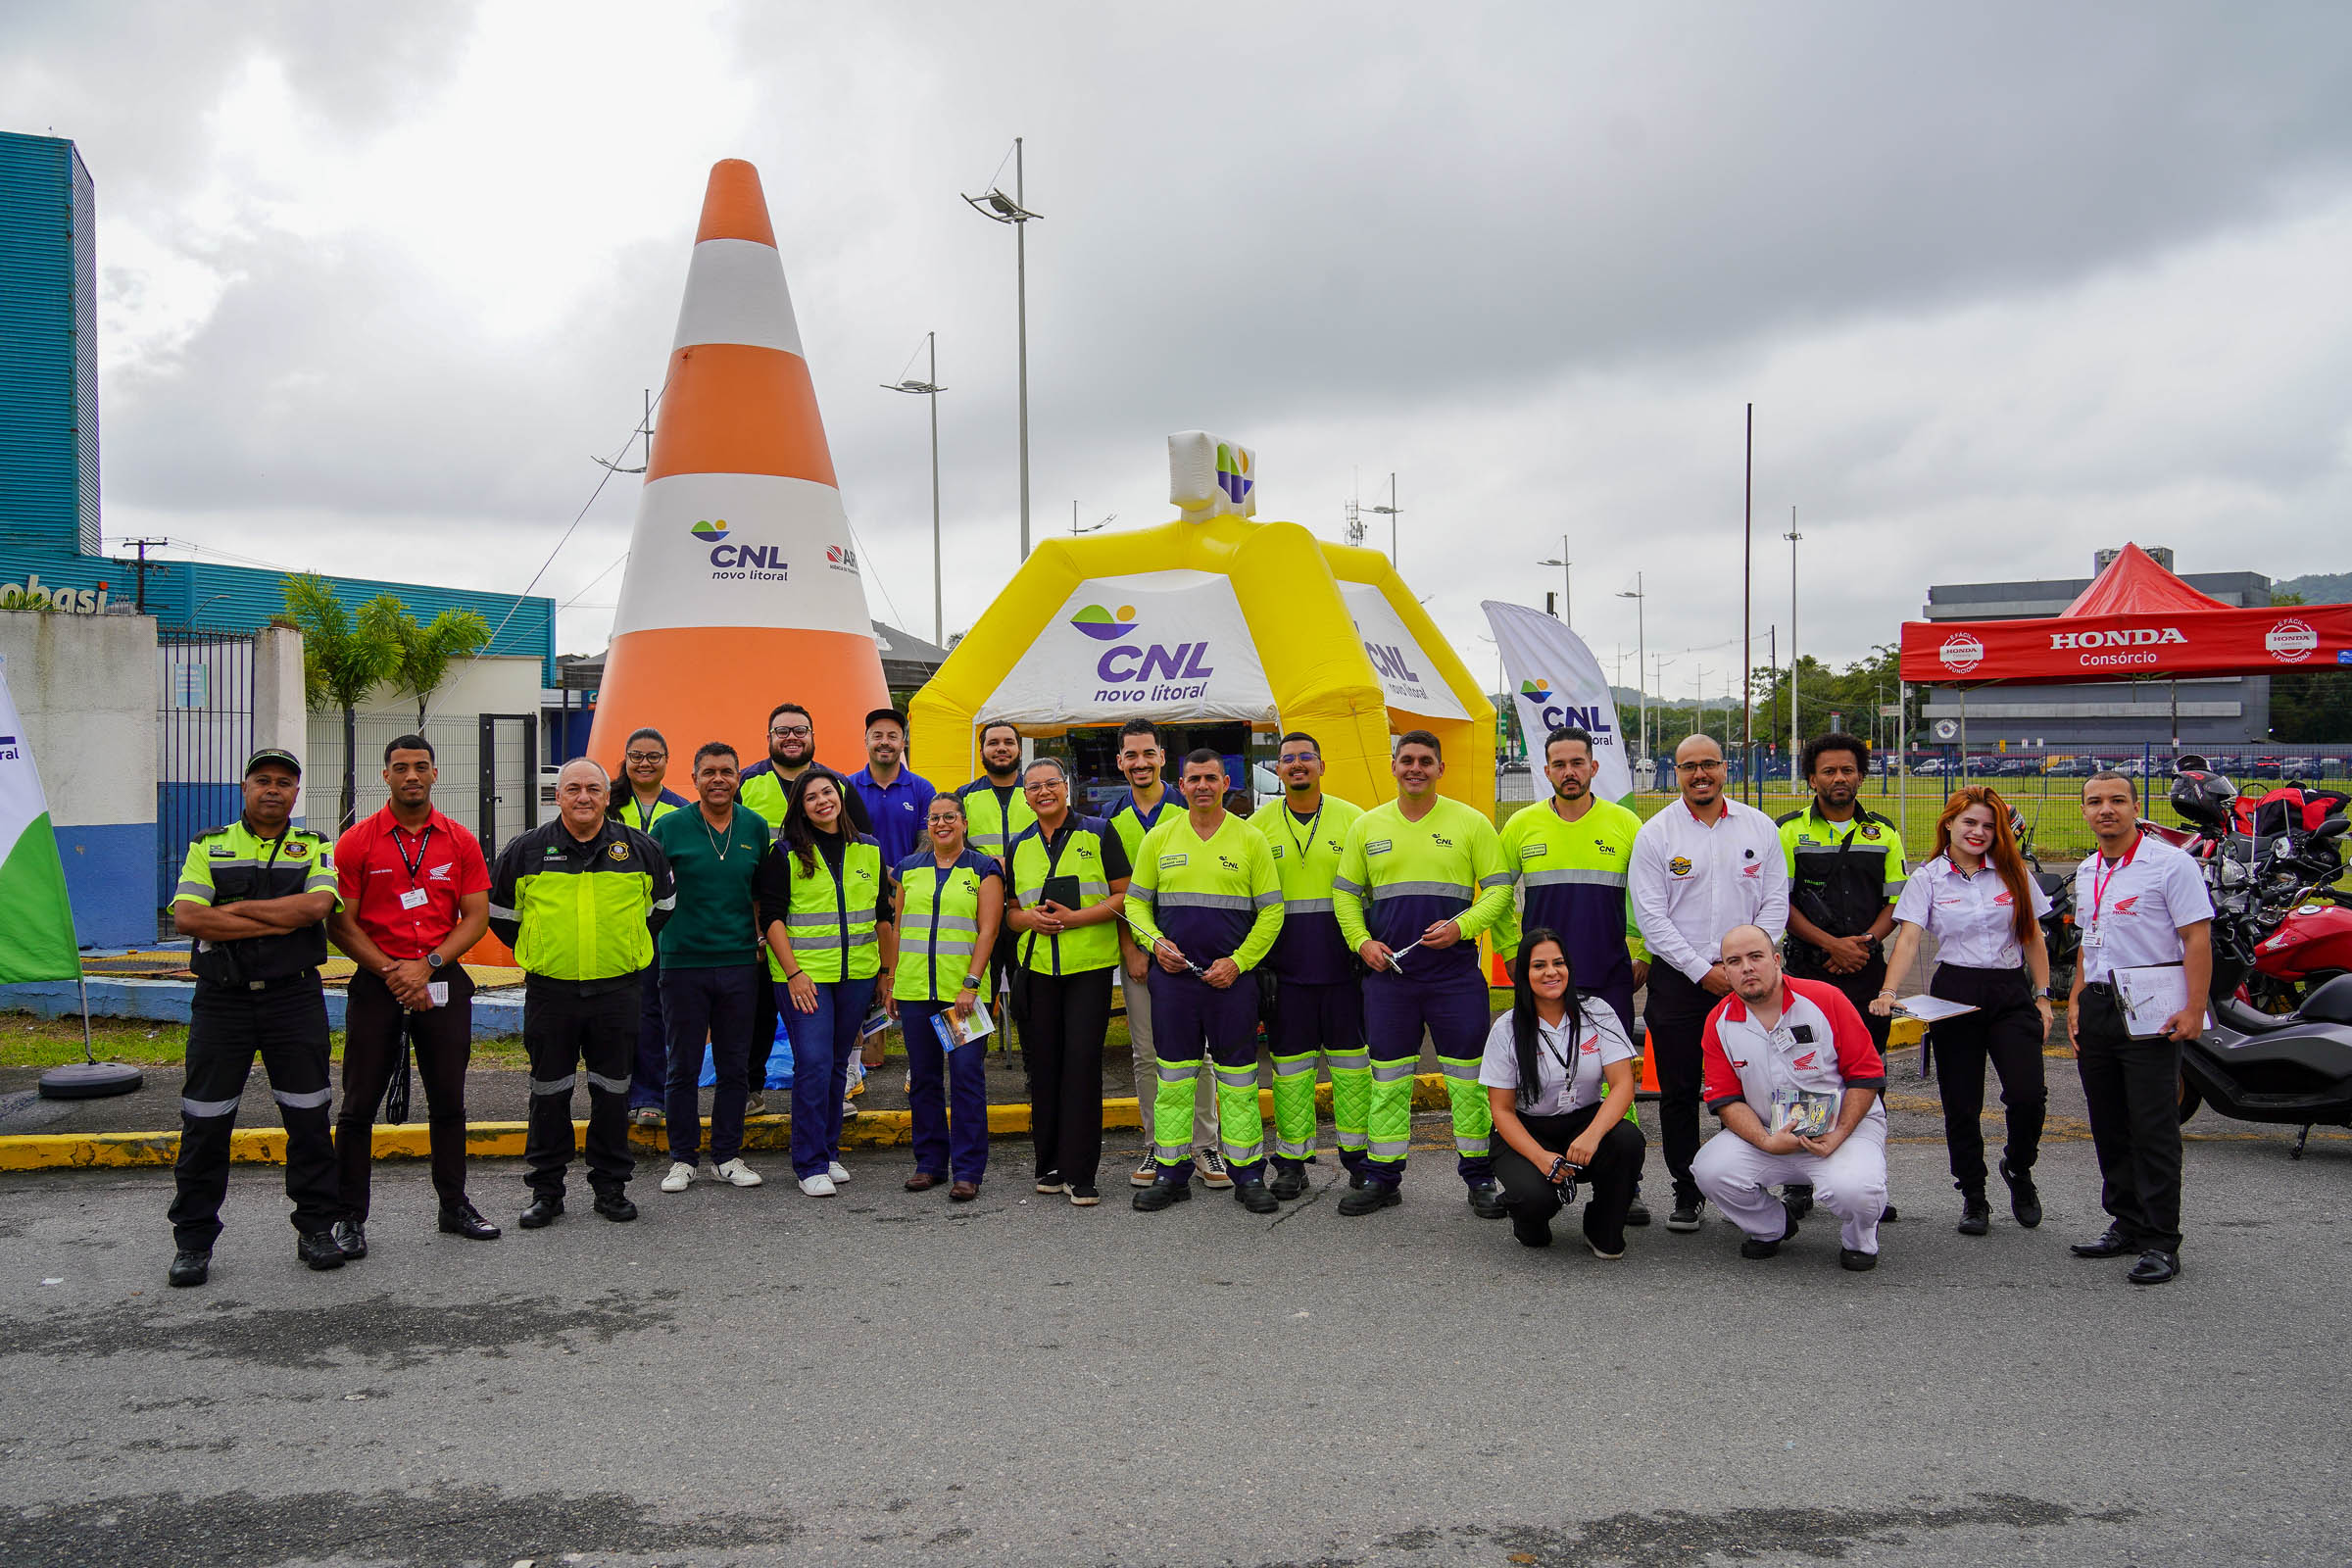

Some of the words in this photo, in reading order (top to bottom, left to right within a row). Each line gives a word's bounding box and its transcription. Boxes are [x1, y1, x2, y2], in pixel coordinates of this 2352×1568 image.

[710, 544, 789, 570] CNL
[843, 548, 859, 570] AR
[711, 570, 746, 580] novo
[750, 569, 788, 581] litoral
[2283, 616, 2304, 627] FÁCIL
[2050, 627, 2188, 650] HONDA
[1097, 642, 1214, 683] CNL
[1364, 641, 1420, 683] CNL
[2080, 651, 2157, 666] Consórcio
[2276, 650, 2312, 663] FUNCIONA
[1948, 662, 1980, 674] FUNCIONA
[1094, 689, 1146, 702] novo
[1151, 682, 1208, 702] litoral
[1542, 706, 1611, 733] CNL
[1591, 735, 1613, 746] oral
